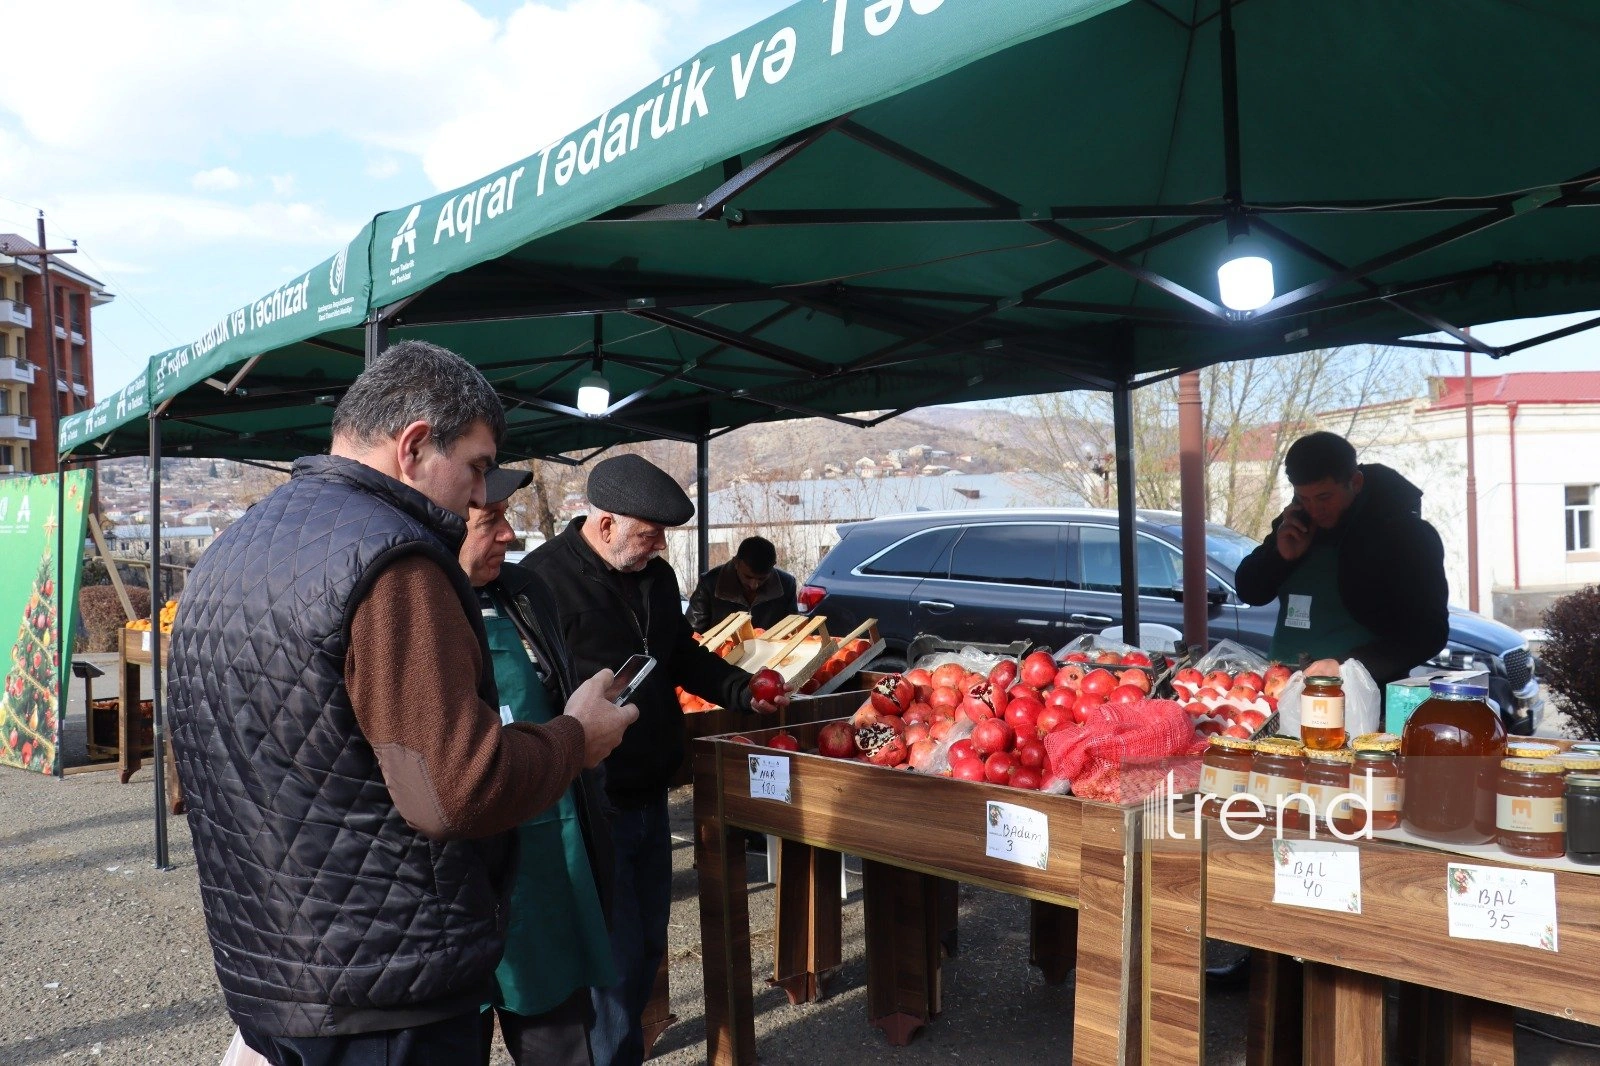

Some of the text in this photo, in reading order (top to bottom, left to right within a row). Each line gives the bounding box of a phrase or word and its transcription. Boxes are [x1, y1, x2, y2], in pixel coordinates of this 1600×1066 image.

[432, 0, 946, 245] Aqrar Tədarük və Tə
[760, 770, 775, 780] NAR
[1006, 840, 1014, 852] 3
[1293, 861, 1327, 877] BAL
[1303, 878, 1323, 898] 40
[1478, 889, 1516, 907] BAL
[1487, 909, 1516, 930] 35
